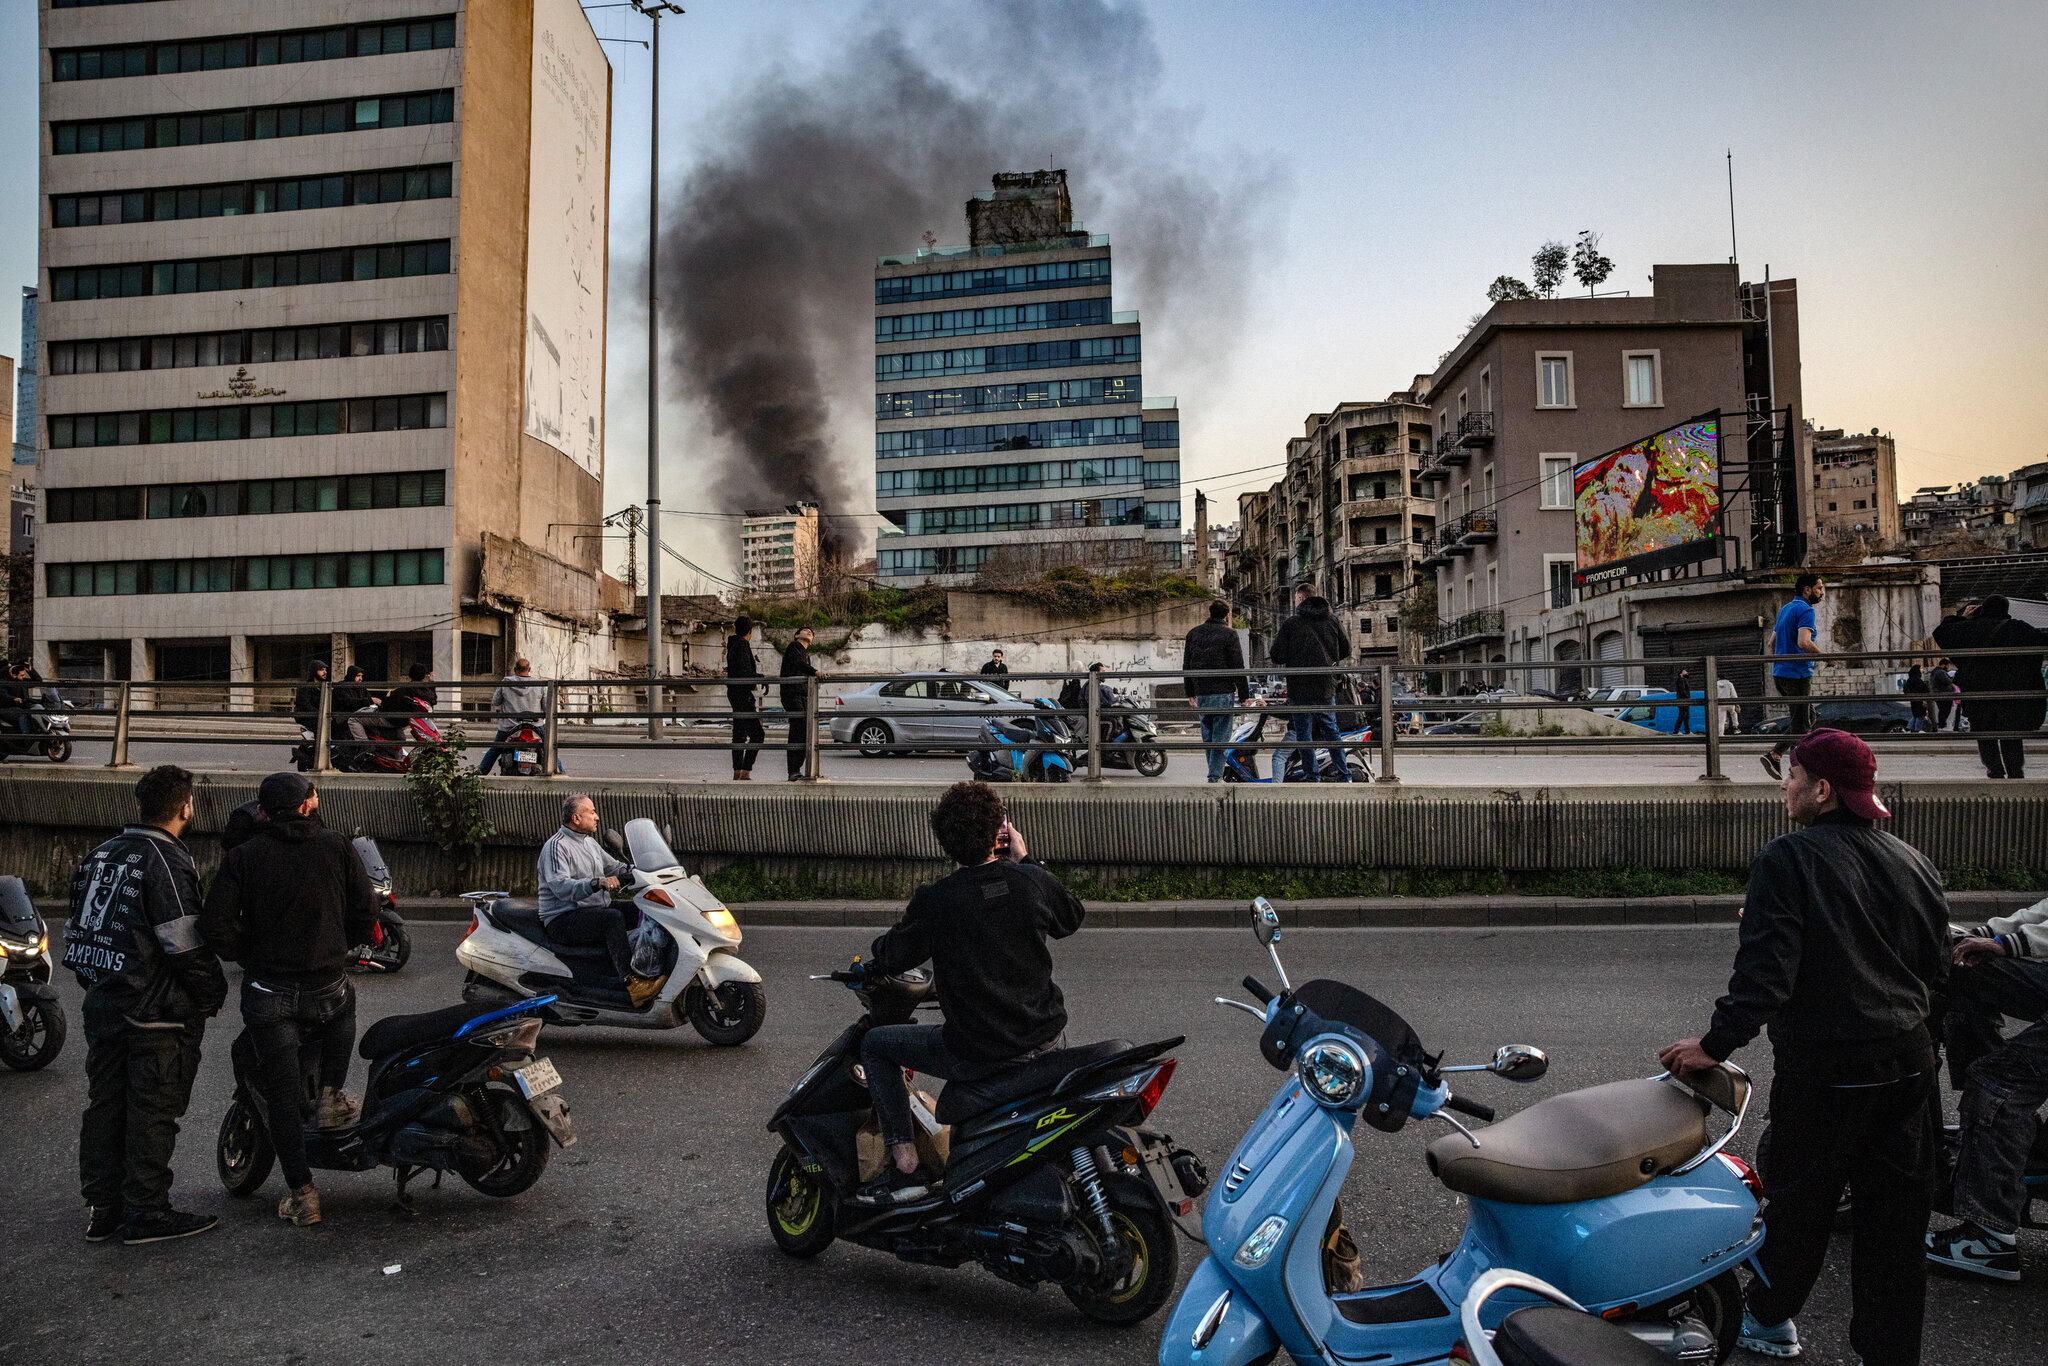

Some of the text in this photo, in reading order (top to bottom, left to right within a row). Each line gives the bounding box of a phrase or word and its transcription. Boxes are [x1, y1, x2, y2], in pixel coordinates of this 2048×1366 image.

[1586, 566, 1628, 584] PROMOMEDIA
[125, 853, 143, 864] 1957
[130, 868, 144, 881] 195
[111, 921, 127, 932] 196
[63, 943, 126, 972] AMPIONS
[75, 966, 98, 983] 903
[1035, 1107, 1077, 1130] GR
